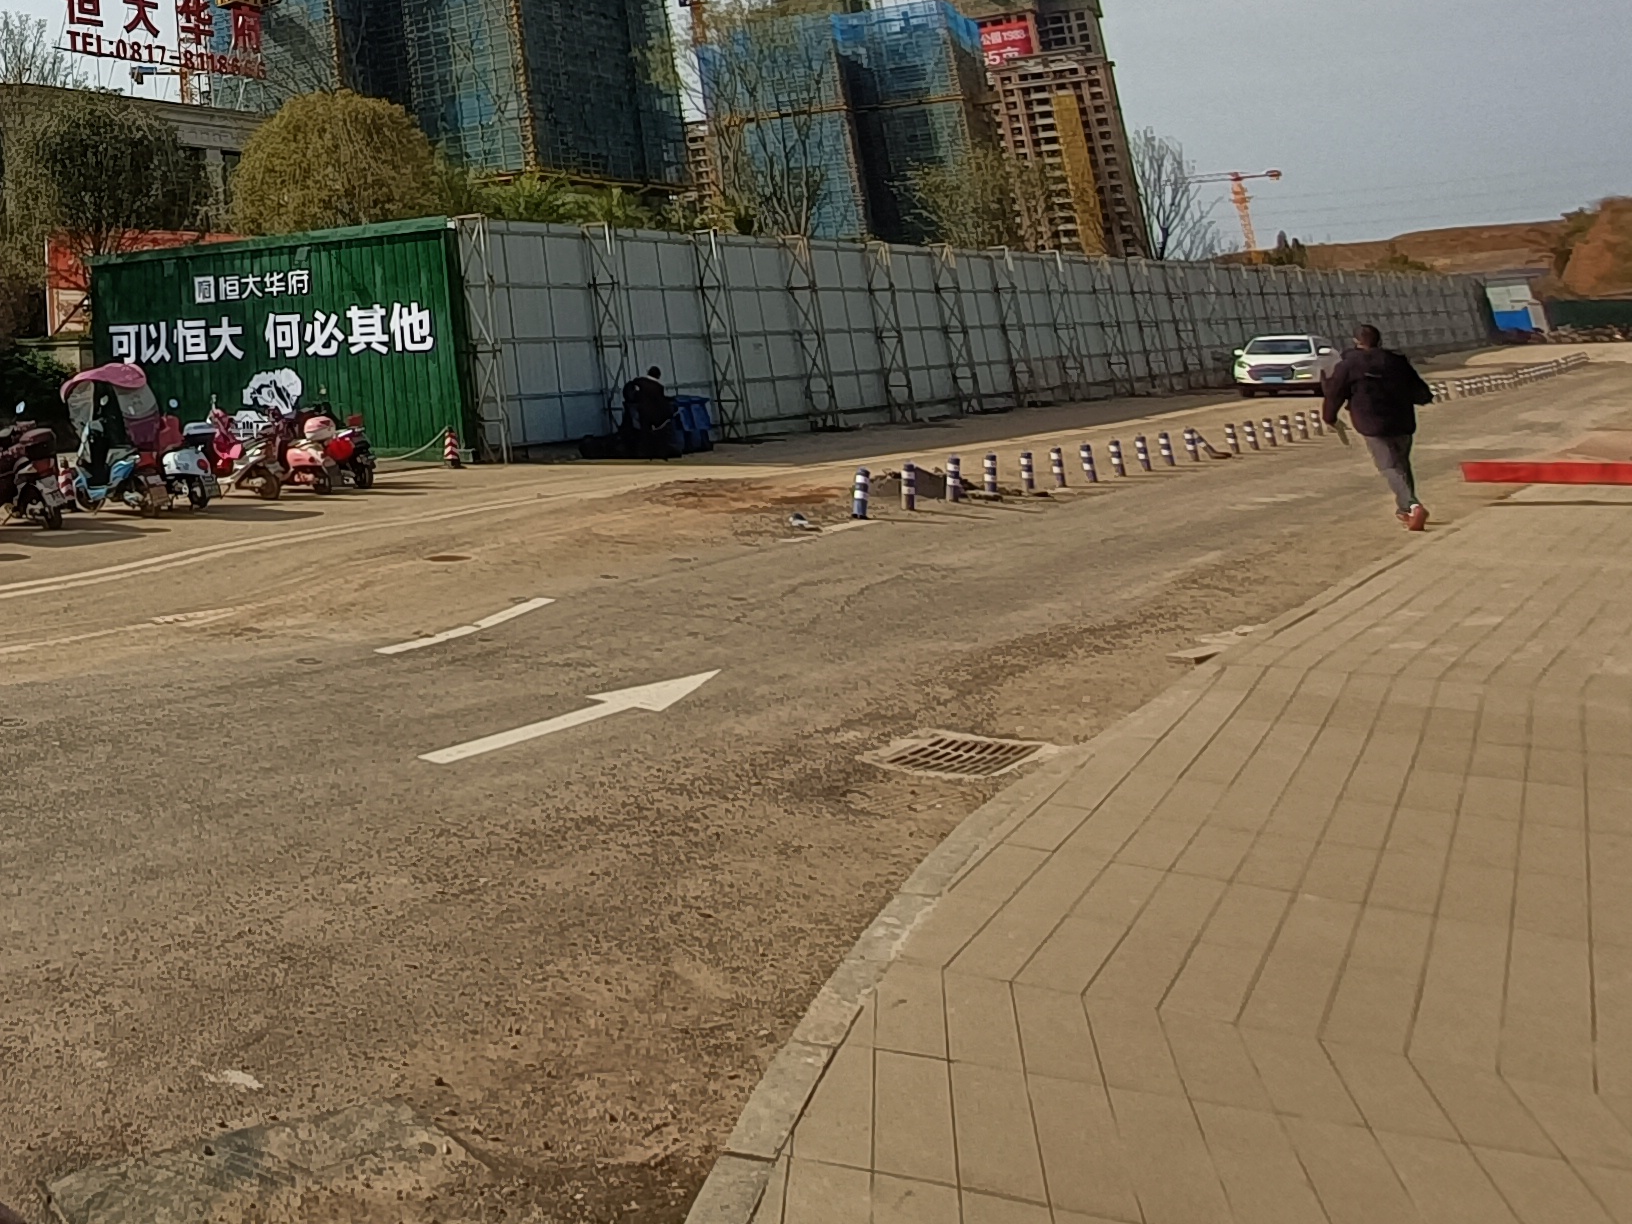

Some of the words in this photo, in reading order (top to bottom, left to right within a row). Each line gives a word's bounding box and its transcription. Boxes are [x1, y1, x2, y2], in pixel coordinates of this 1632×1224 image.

[219, 269, 310, 301] 恒大华府
[108, 316, 245, 364] 可以恒大
[264, 302, 435, 359] 何必其他
